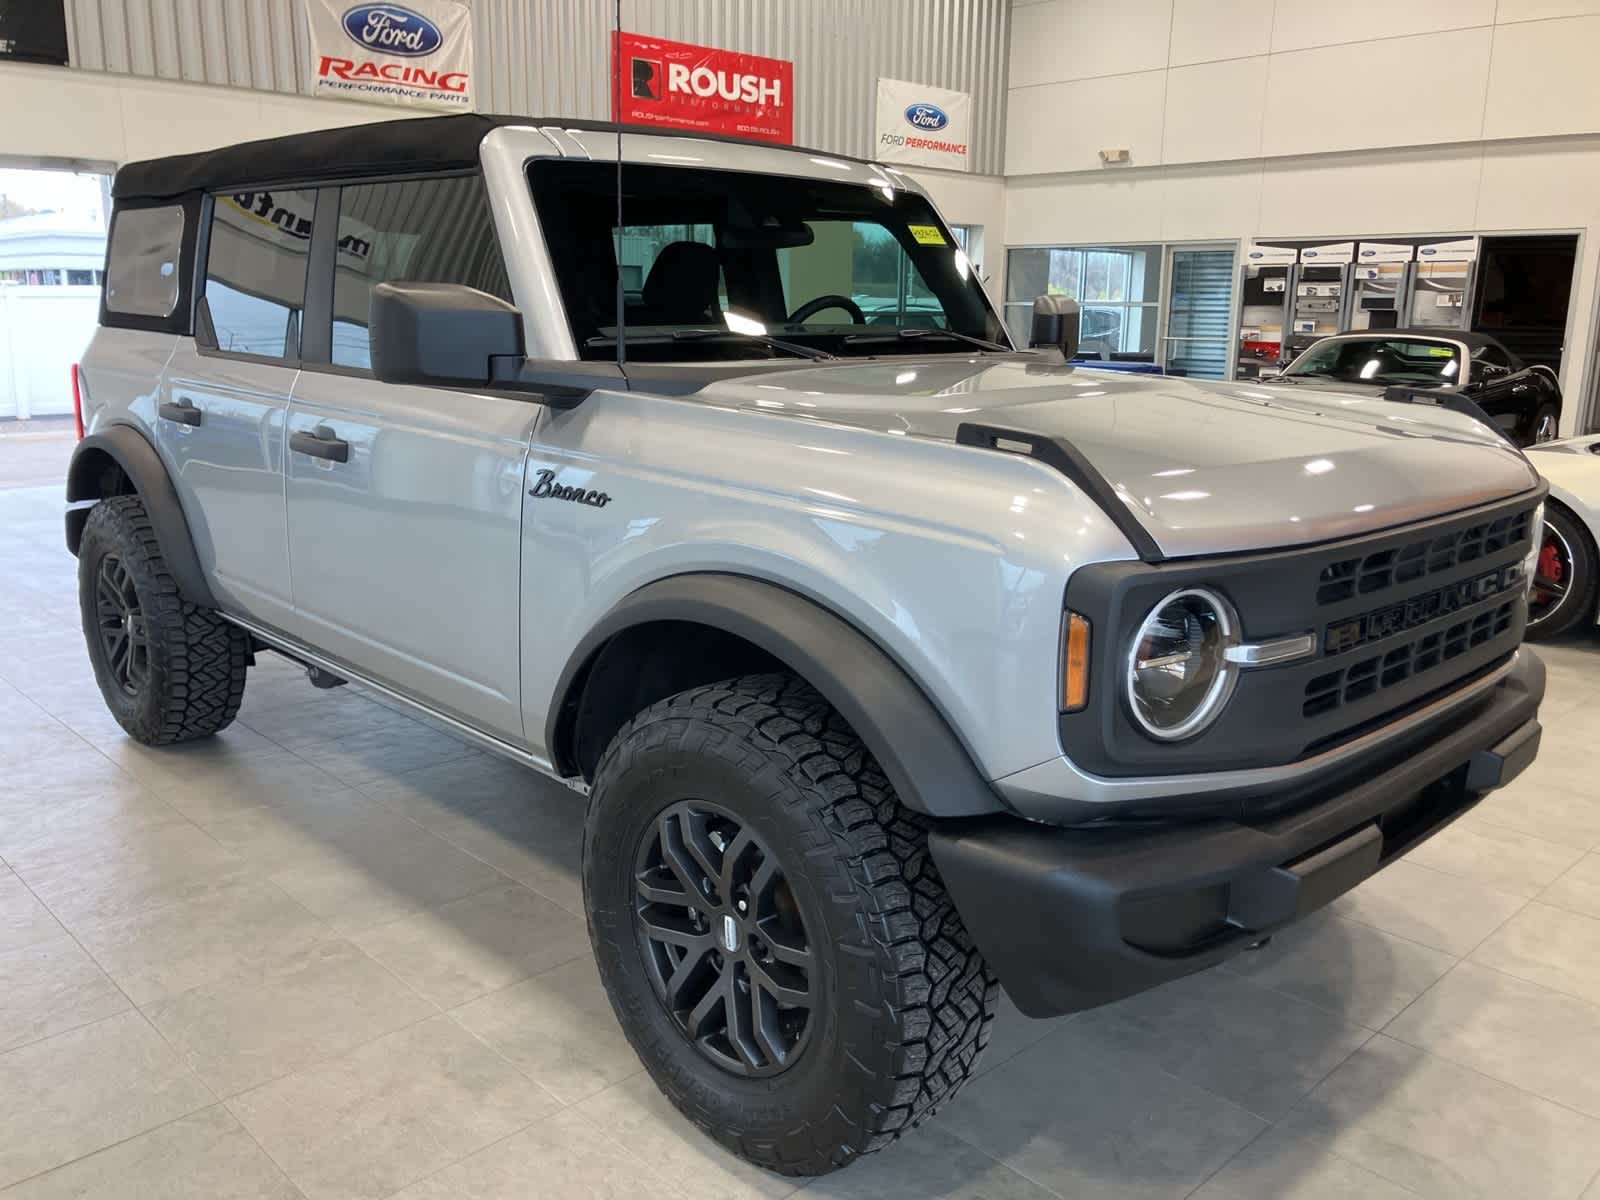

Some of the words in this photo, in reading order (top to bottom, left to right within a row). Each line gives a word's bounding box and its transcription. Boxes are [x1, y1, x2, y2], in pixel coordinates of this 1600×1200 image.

[362, 10, 424, 50] Ford
[318, 56, 469, 92] RACING
[319, 79, 424, 98] PERFORMANCE
[429, 92, 469, 103] PARTS
[668, 62, 782, 107] ROUSH
[913, 107, 940, 127] Ford
[880, 134, 904, 145] FORD
[904, 137, 967, 155] PERFORMANCE
[528, 468, 613, 508] Bronco
